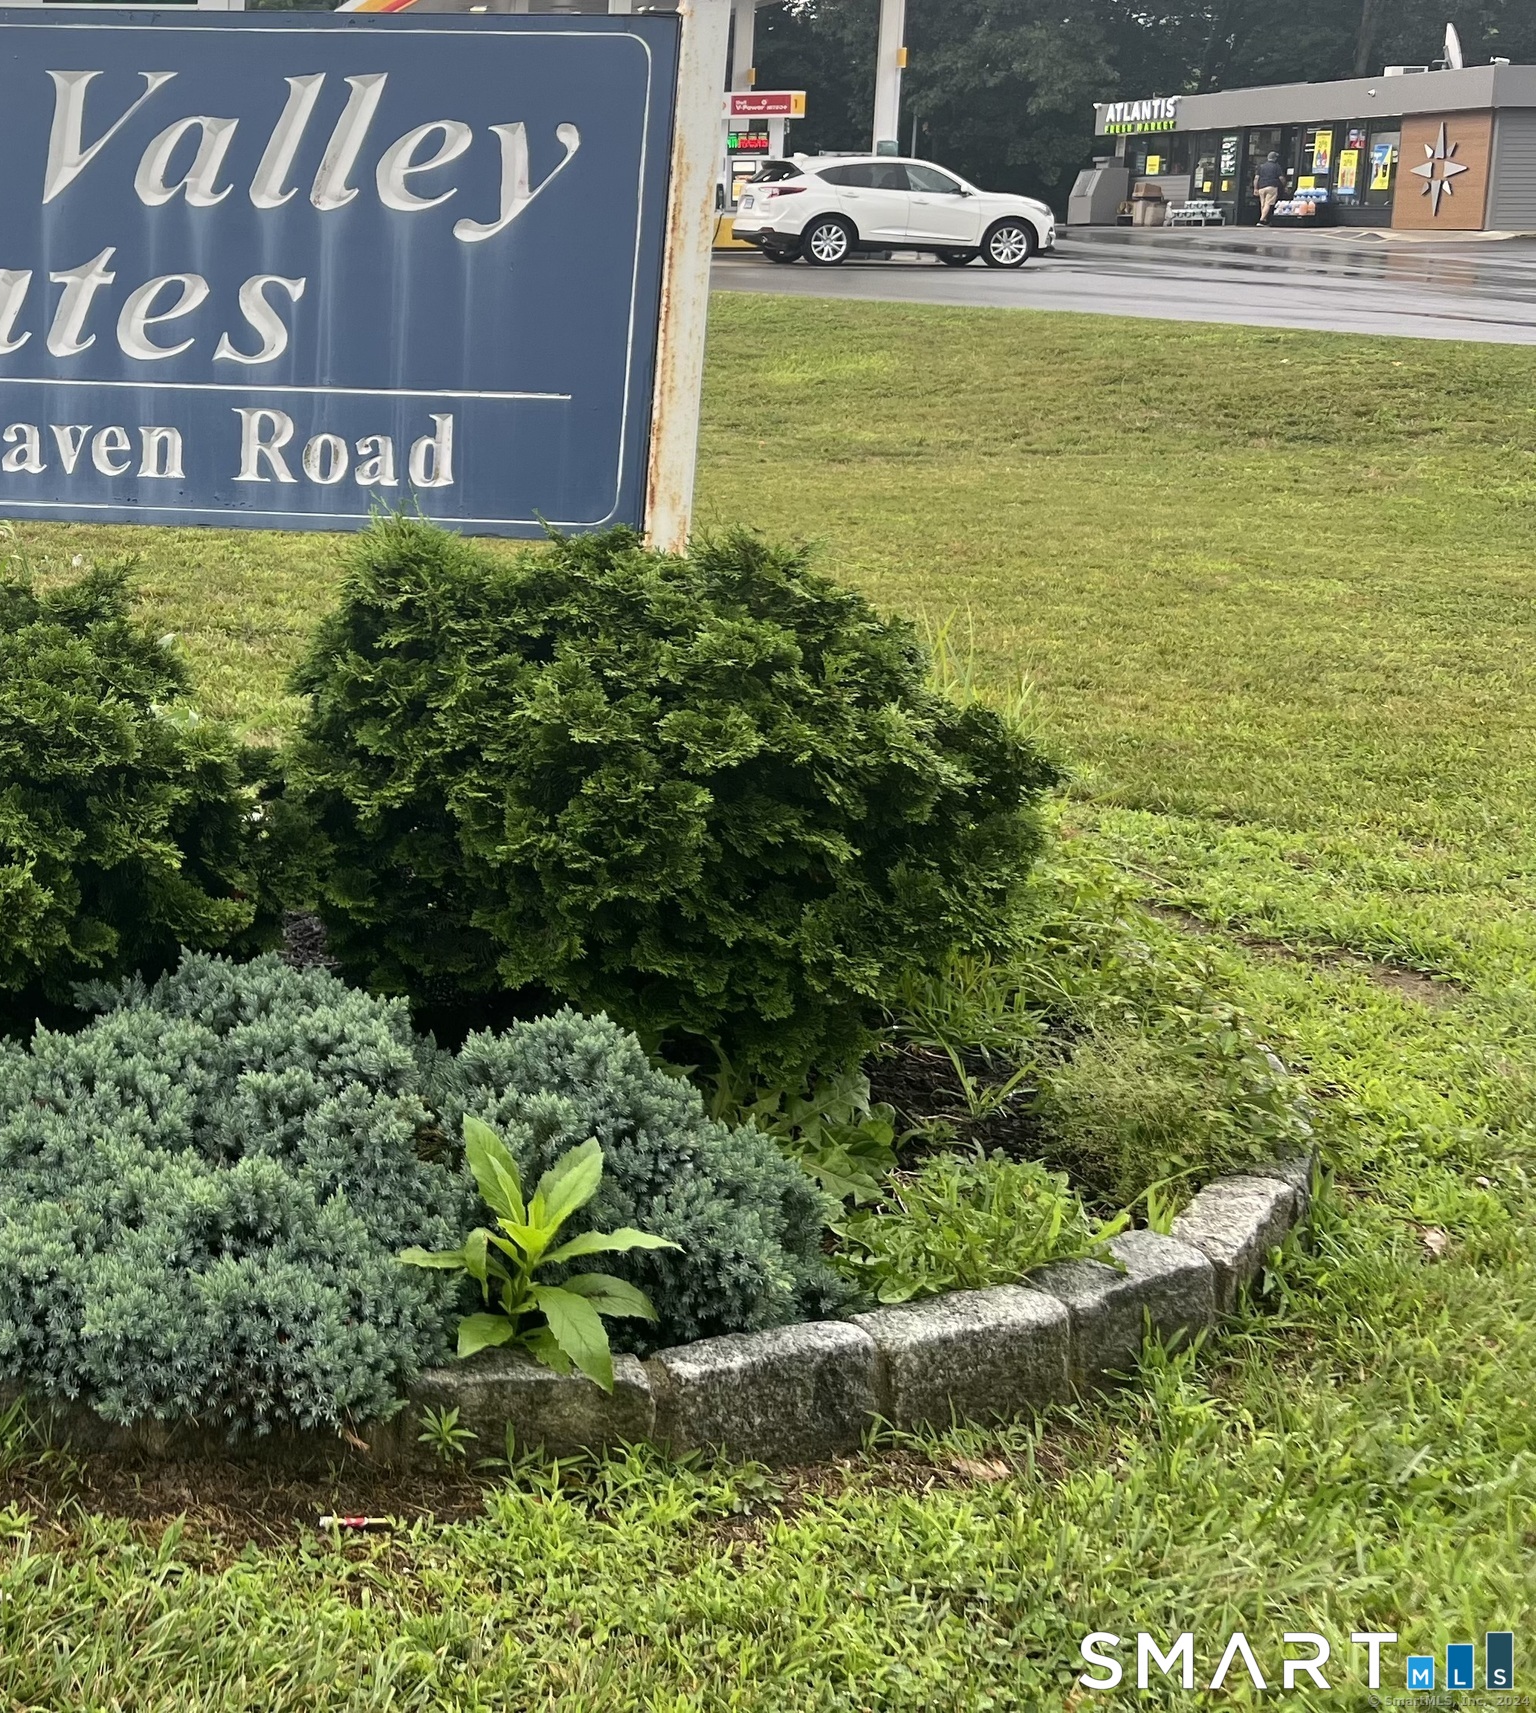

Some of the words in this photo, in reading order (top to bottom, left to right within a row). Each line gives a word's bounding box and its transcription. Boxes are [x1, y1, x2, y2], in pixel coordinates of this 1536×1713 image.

[1104, 124, 1133, 134] FRESH
[1136, 120, 1175, 132] MARKET
[1105, 98, 1176, 123] ATLANTIS
[43, 70, 582, 243] Valley
[232, 406, 454, 489] Road
